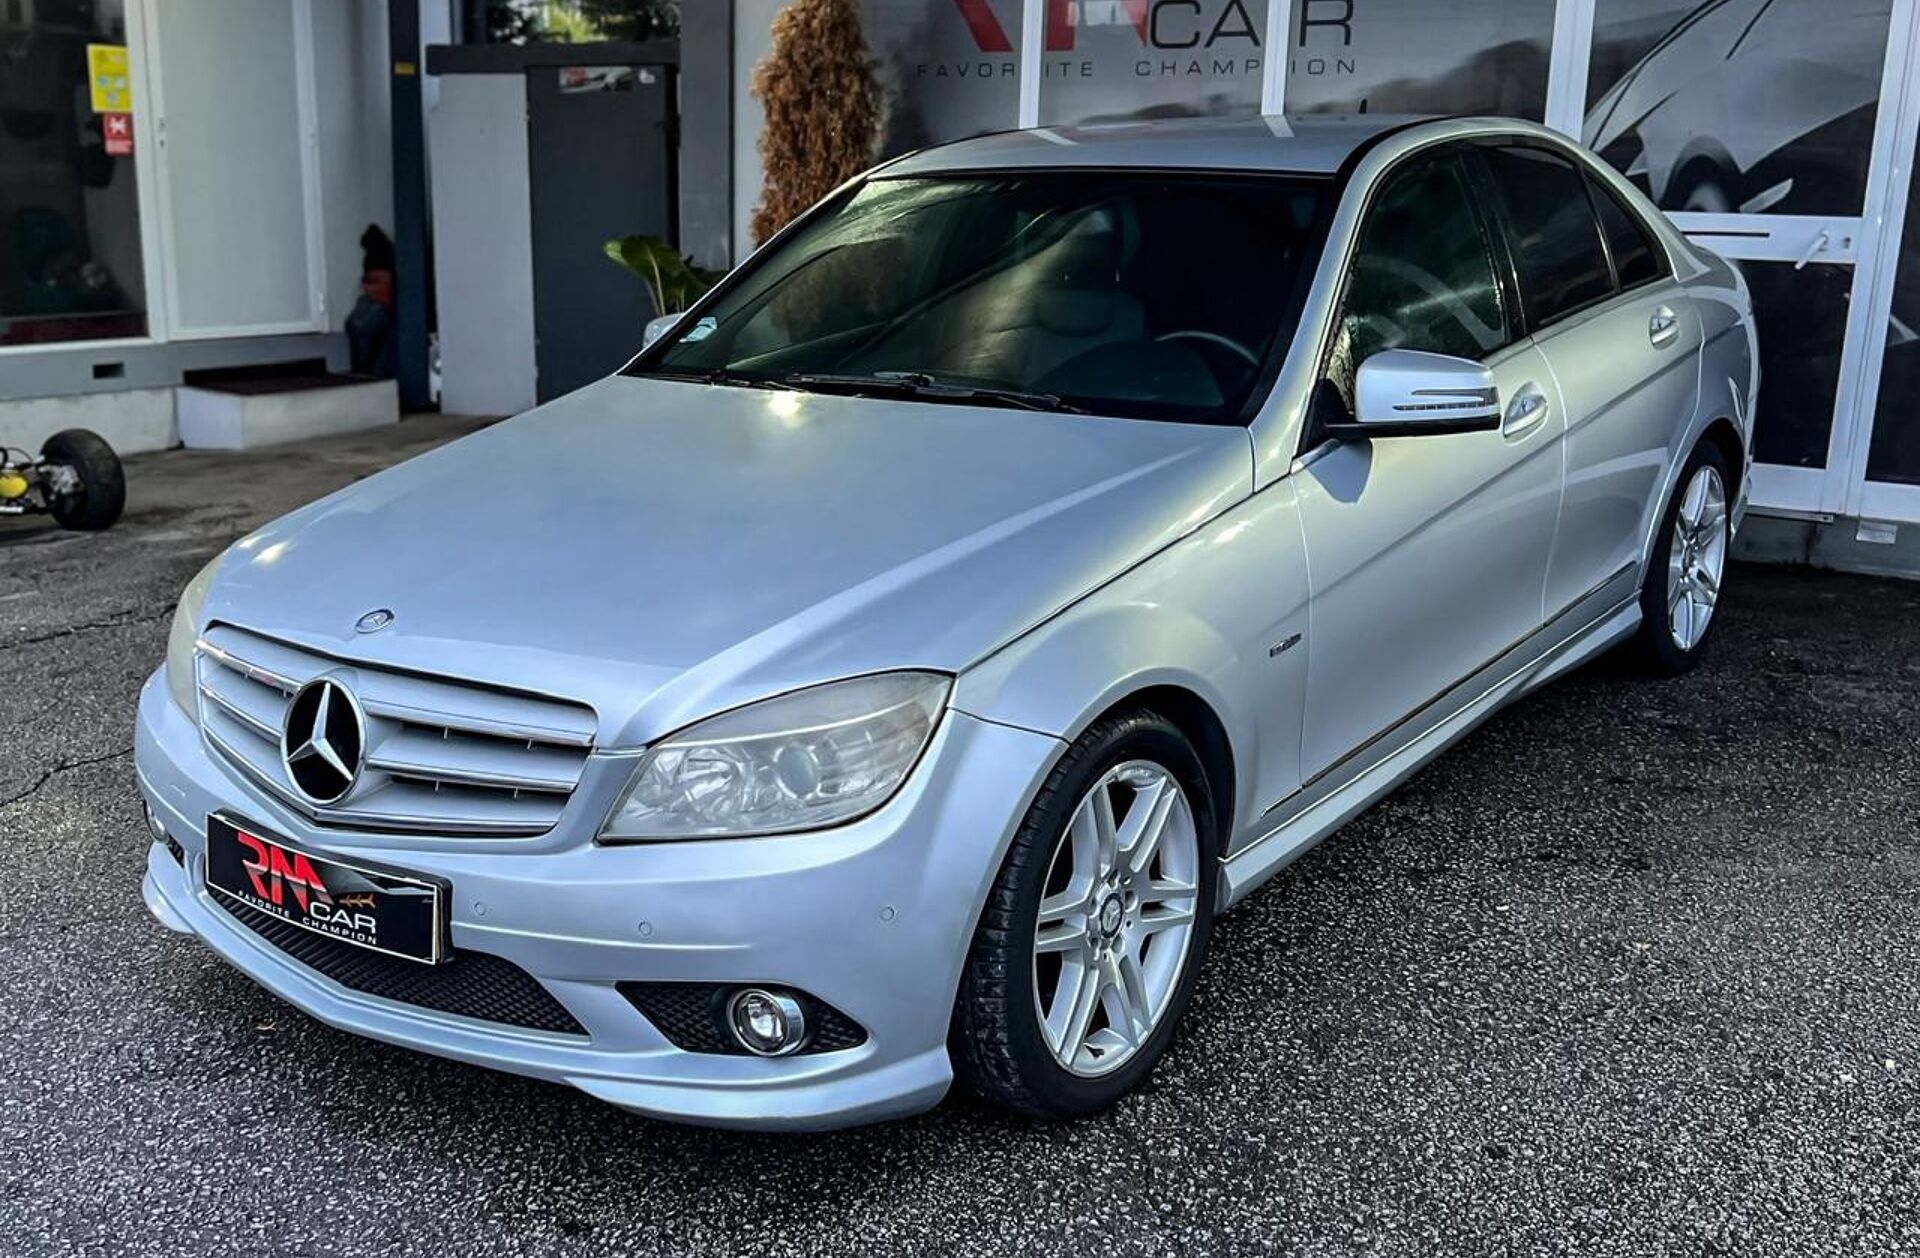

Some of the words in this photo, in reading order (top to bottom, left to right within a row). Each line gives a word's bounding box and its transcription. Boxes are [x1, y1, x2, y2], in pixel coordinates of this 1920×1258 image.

[1150, 0, 1354, 49] CAR
[917, 61, 1093, 78] FAVORITE
[1135, 58, 1355, 76] CHAMPION
[238, 831, 334, 913] RM
[238, 889, 291, 918] FAVORITE
[302, 916, 377, 945] CHAMPION
[309, 901, 377, 934] CAR
